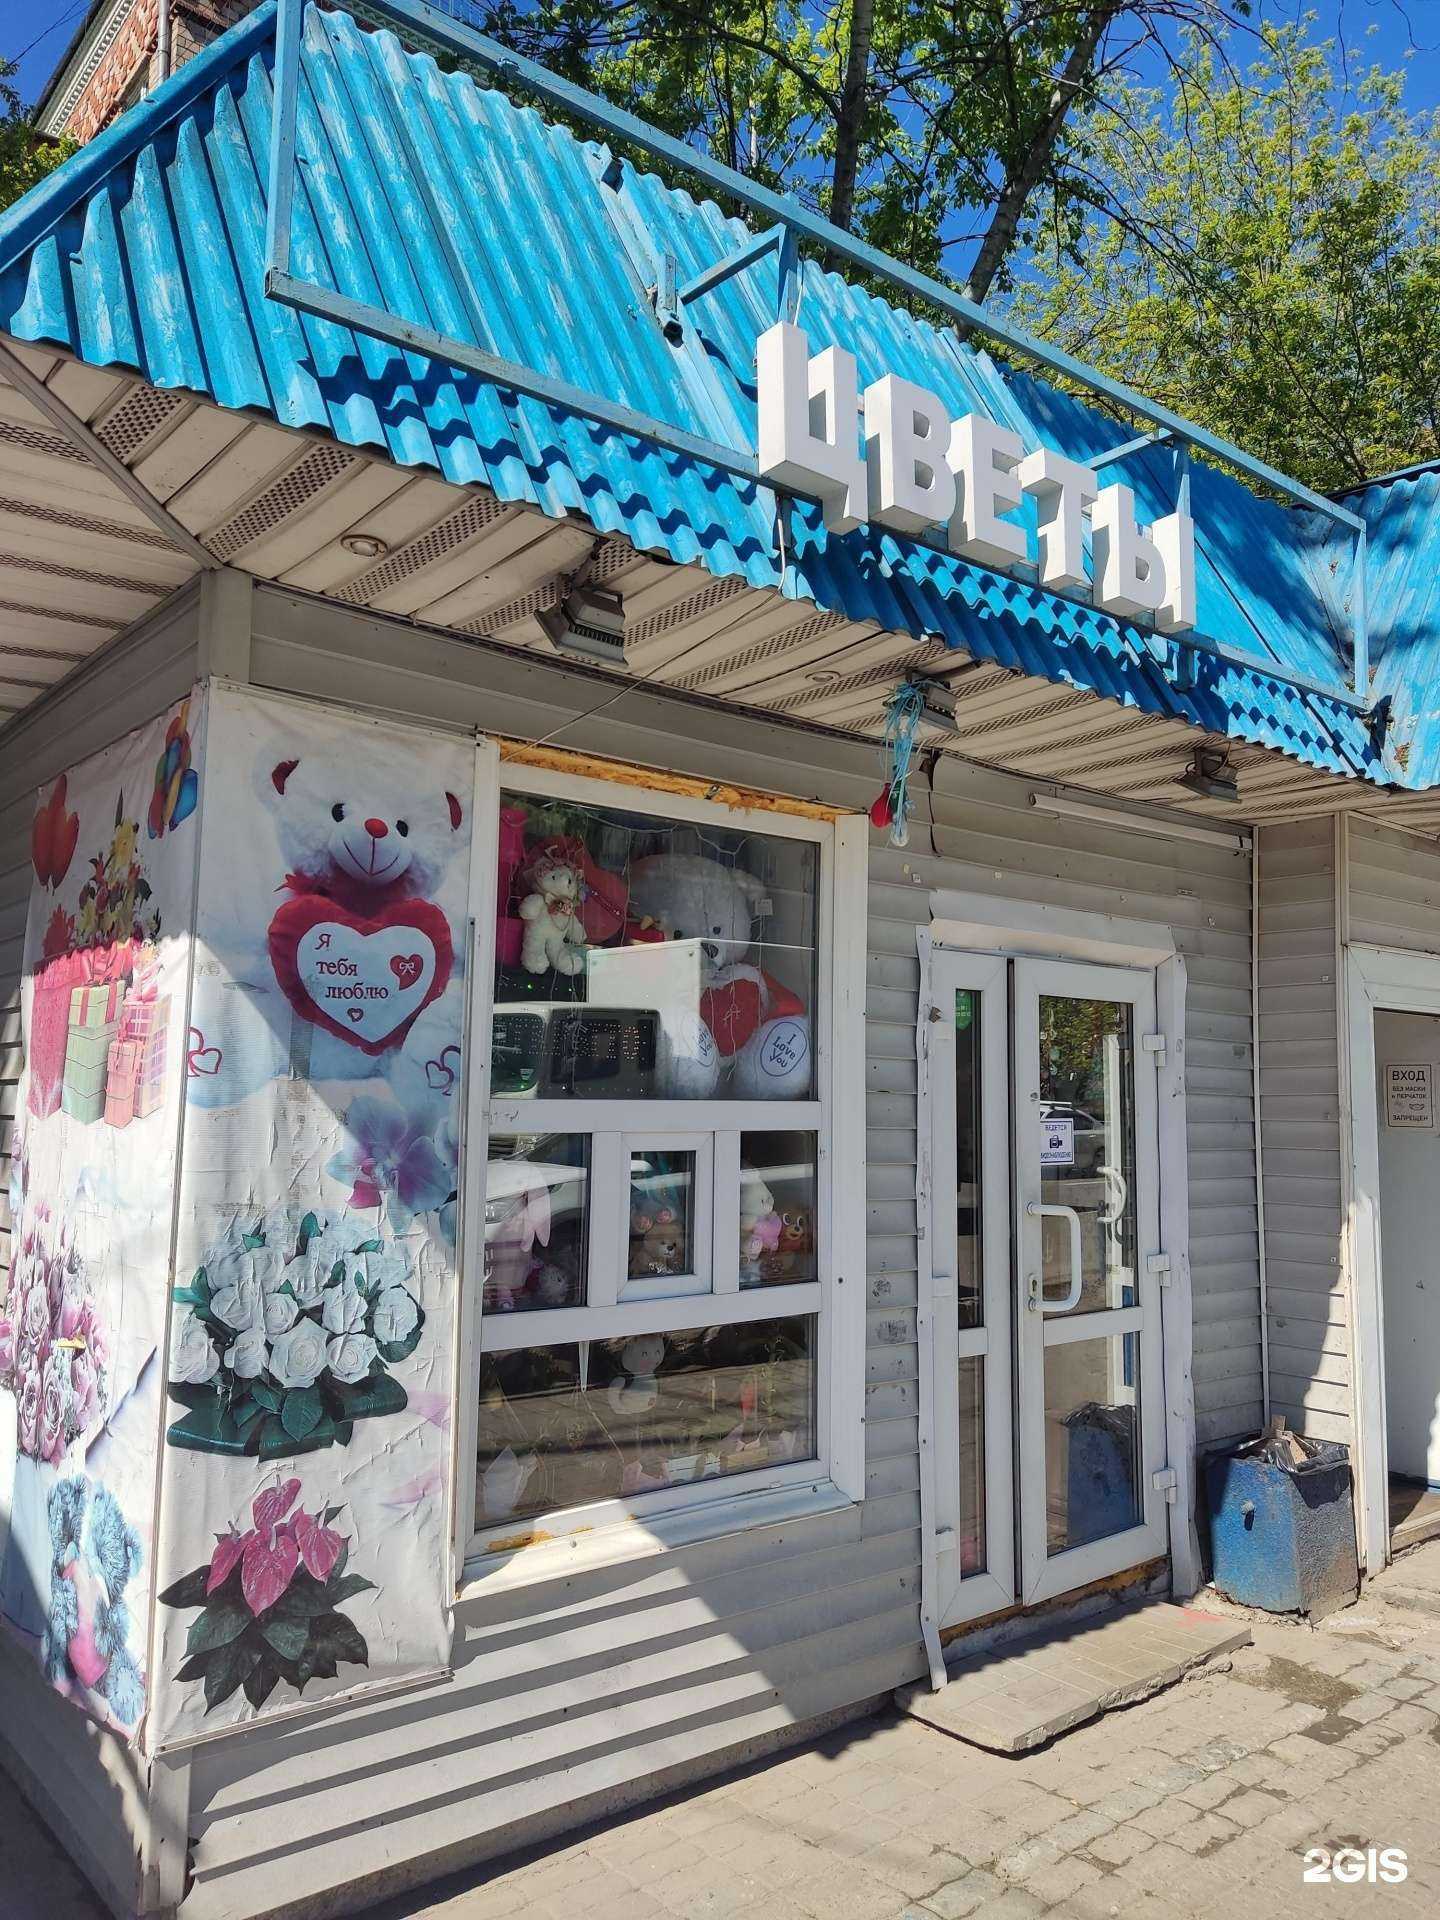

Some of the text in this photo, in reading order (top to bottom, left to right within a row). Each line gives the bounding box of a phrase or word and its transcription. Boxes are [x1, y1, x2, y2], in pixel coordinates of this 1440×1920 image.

[757, 321, 1196, 633] ЦВЕТЫ
[314, 933, 332, 950] Я
[316, 958, 358, 976] тебя
[325, 982, 389, 1000] люблю
[786, 1034, 797, 1046] I
[1392, 1070, 1426, 1082] ВХОД
